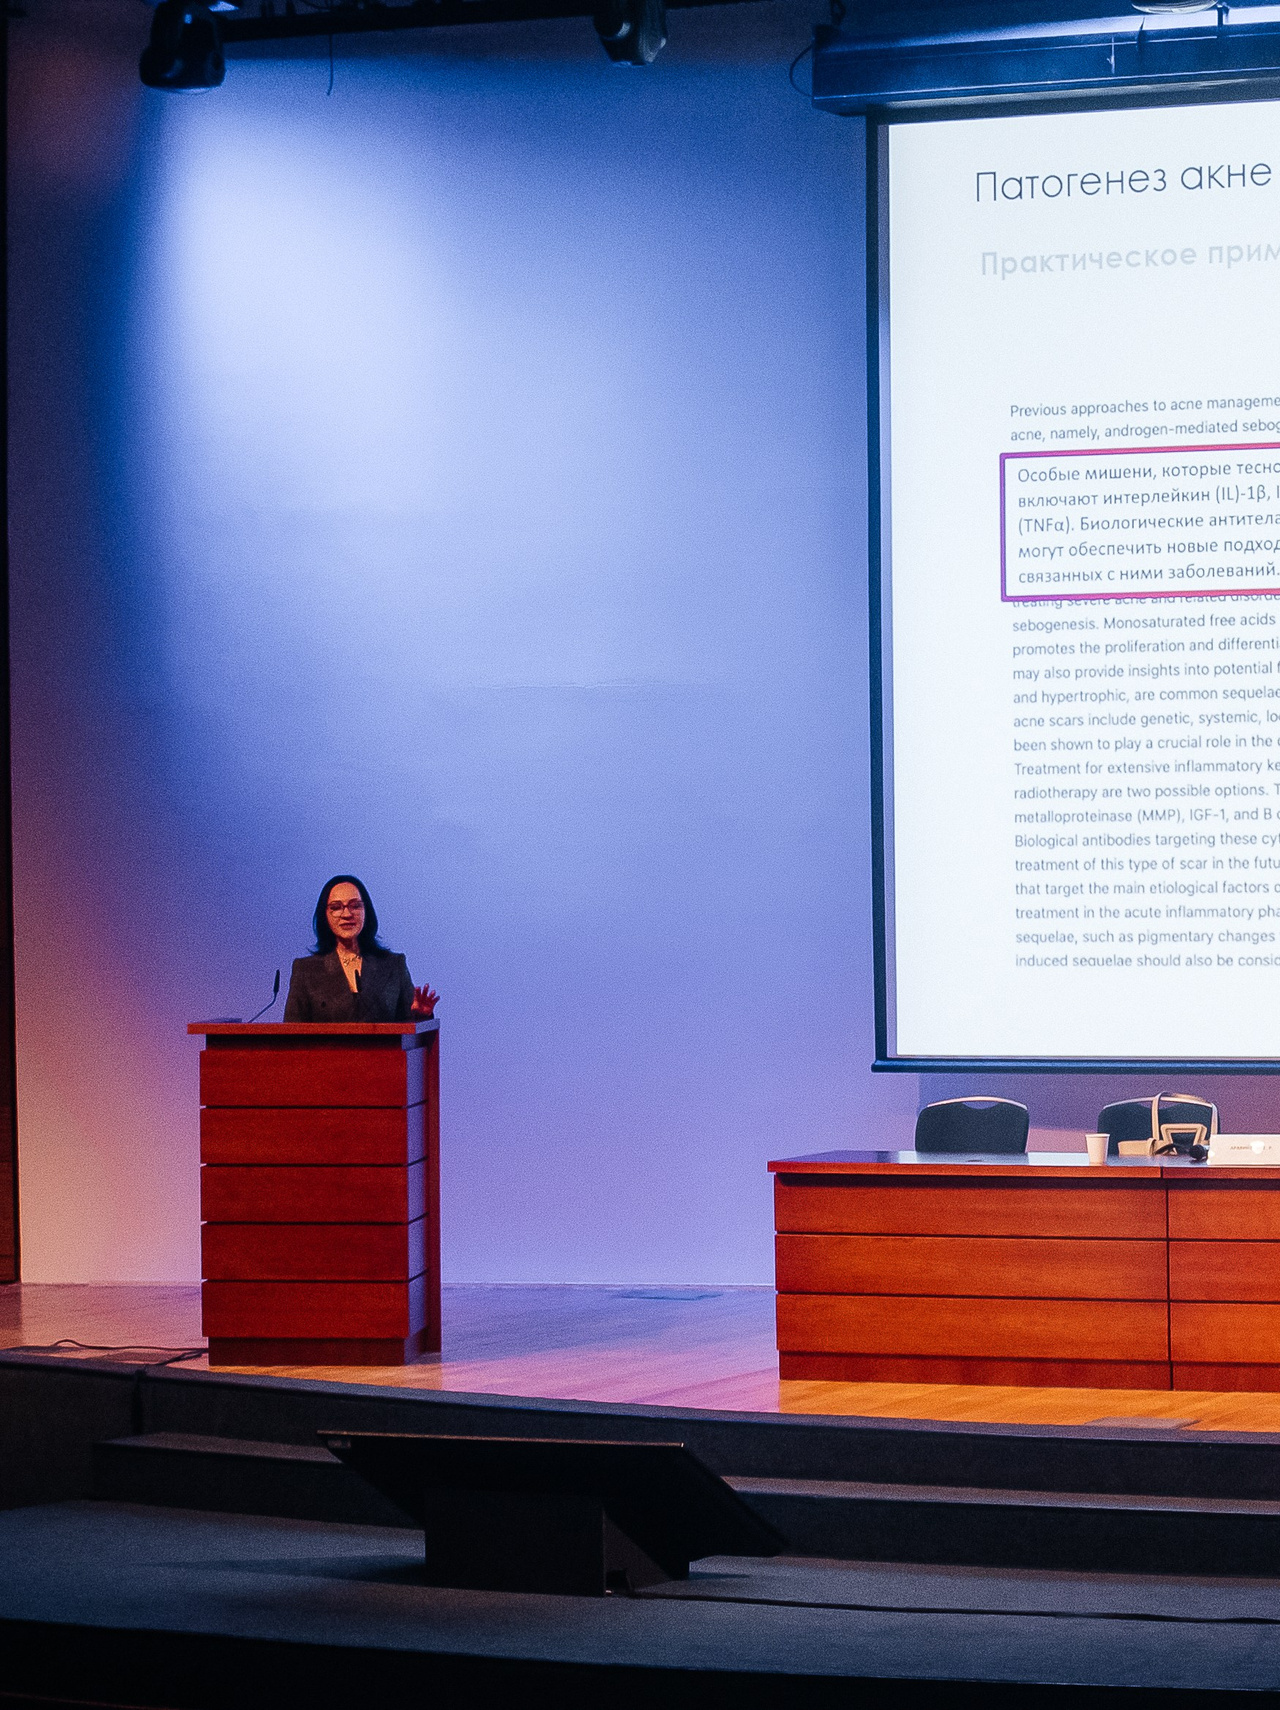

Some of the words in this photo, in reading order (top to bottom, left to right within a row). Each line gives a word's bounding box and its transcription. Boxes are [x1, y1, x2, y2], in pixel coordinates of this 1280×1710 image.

[975, 168, 1168, 201] Патогенез
[1180, 161, 1273, 190] акне
[981, 247, 1198, 279] Практическое
[1009, 402, 1068, 417] Previous
[1070, 399, 1150, 417] approaches
[1152, 399, 1167, 412] to
[1169, 398, 1203, 411] acne
[1010, 429, 1046, 442] acne,
[1049, 425, 1100, 440] namely,
[1104, 420, 1239, 439] androgen-mediated
[1017, 465, 1081, 483] Особые
[1084, 466, 1157, 480] мишени,
[1161, 463, 1232, 479] которые
[1017, 493, 1099, 508] включают
[1102, 487, 1211, 506] интерлейкин
[1079, 515, 1205, 531] Биологические
[1018, 545, 1064, 560] могут
[1068, 540, 1163, 557] обеспечить
[1166, 540, 1219, 554] новые
[1018, 570, 1103, 584] связанных
[1106, 569, 1115, 581] с
[1119, 568, 1164, 580] ними
[1168, 561, 1280, 580] заболеваний.
[1012, 618, 1100, 634] sebogenesis.
[1103, 614, 1206, 630] Monosaturated
[1209, 613, 1237, 627] free
[1239, 611, 1277, 626] acids
[1013, 716, 1046, 728] acne
[1048, 715, 1085, 727] scars
[1087, 712, 1137, 726] include
[1139, 711, 1194, 728] genetic,
[1198, 710, 1262, 727] systemic,
[1013, 785, 1098, 801] radiotherapy
[1101, 786, 1123, 798] are
[1126, 785, 1152, 798] two
[1154, 783, 1211, 800] possible
[1214, 784, 1269, 799] options.
[1013, 809, 1133, 824] metalloproteinase
[1136, 807, 1185, 824] (MMP),
[1189, 807, 1230, 823] IGF-1,
[1233, 806, 1260, 821] and
[1263, 806, 1273, 821] B
